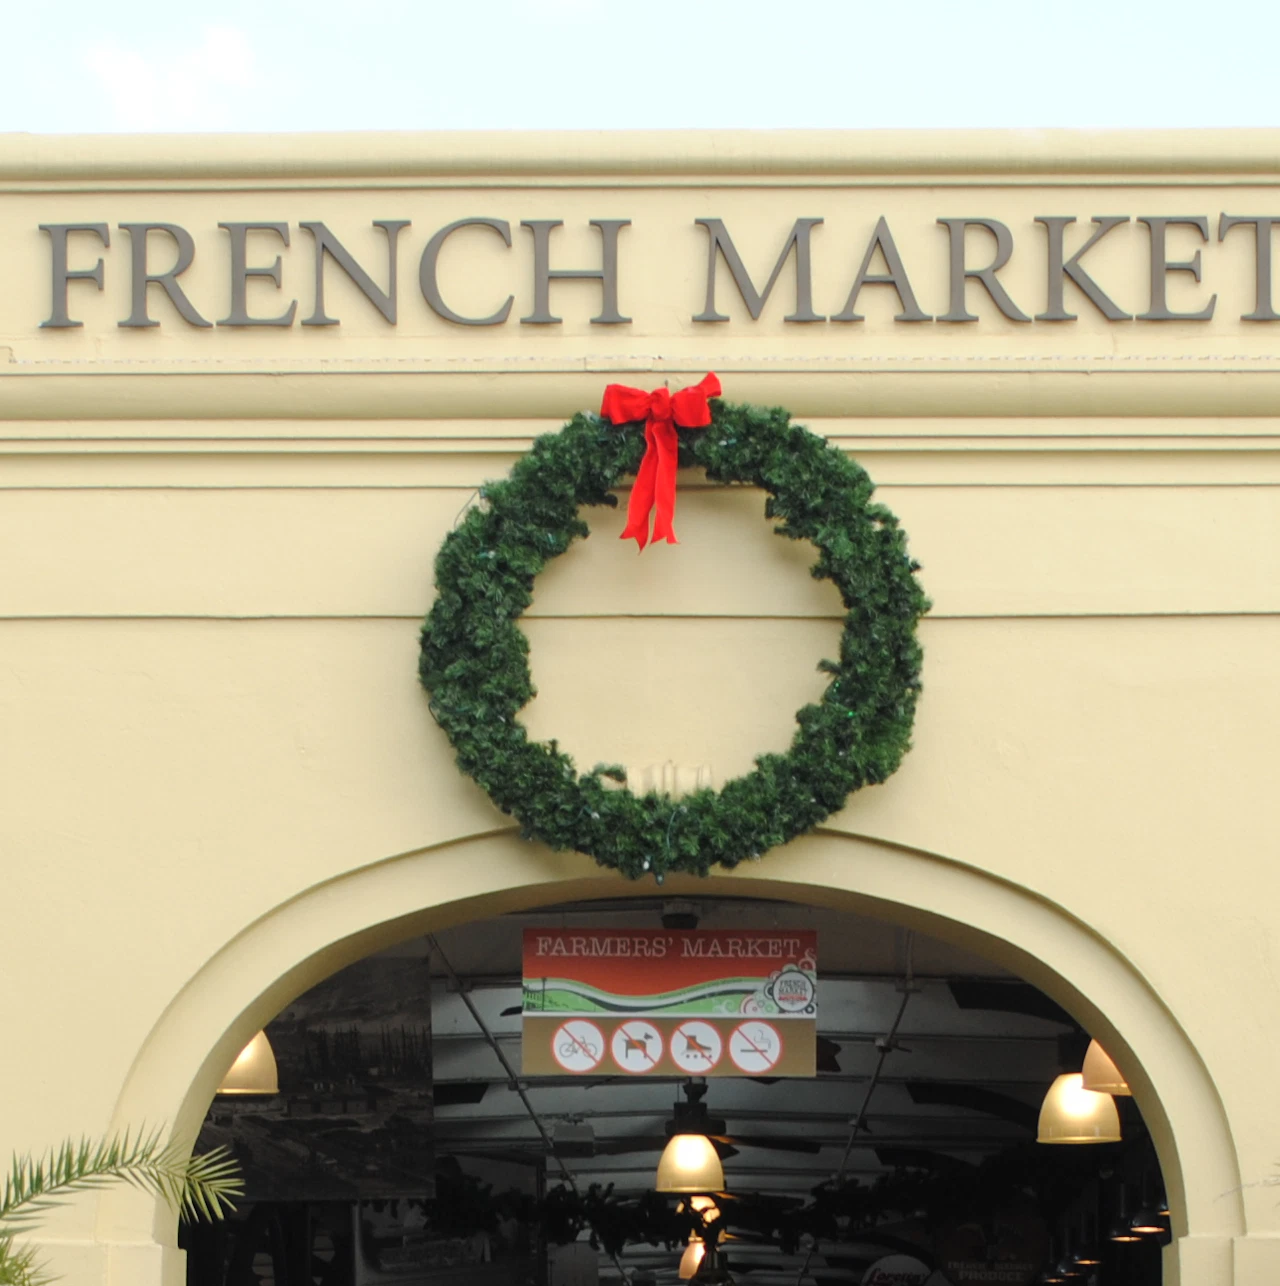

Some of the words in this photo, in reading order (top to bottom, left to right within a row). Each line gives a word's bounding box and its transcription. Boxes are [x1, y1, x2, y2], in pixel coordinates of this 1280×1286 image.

[38, 214, 634, 329] FRENCH
[535, 936, 674, 958] FARMERS'
[679, 938, 801, 960] MARKET
[957, 1270, 1025, 1282] PRODUCE
